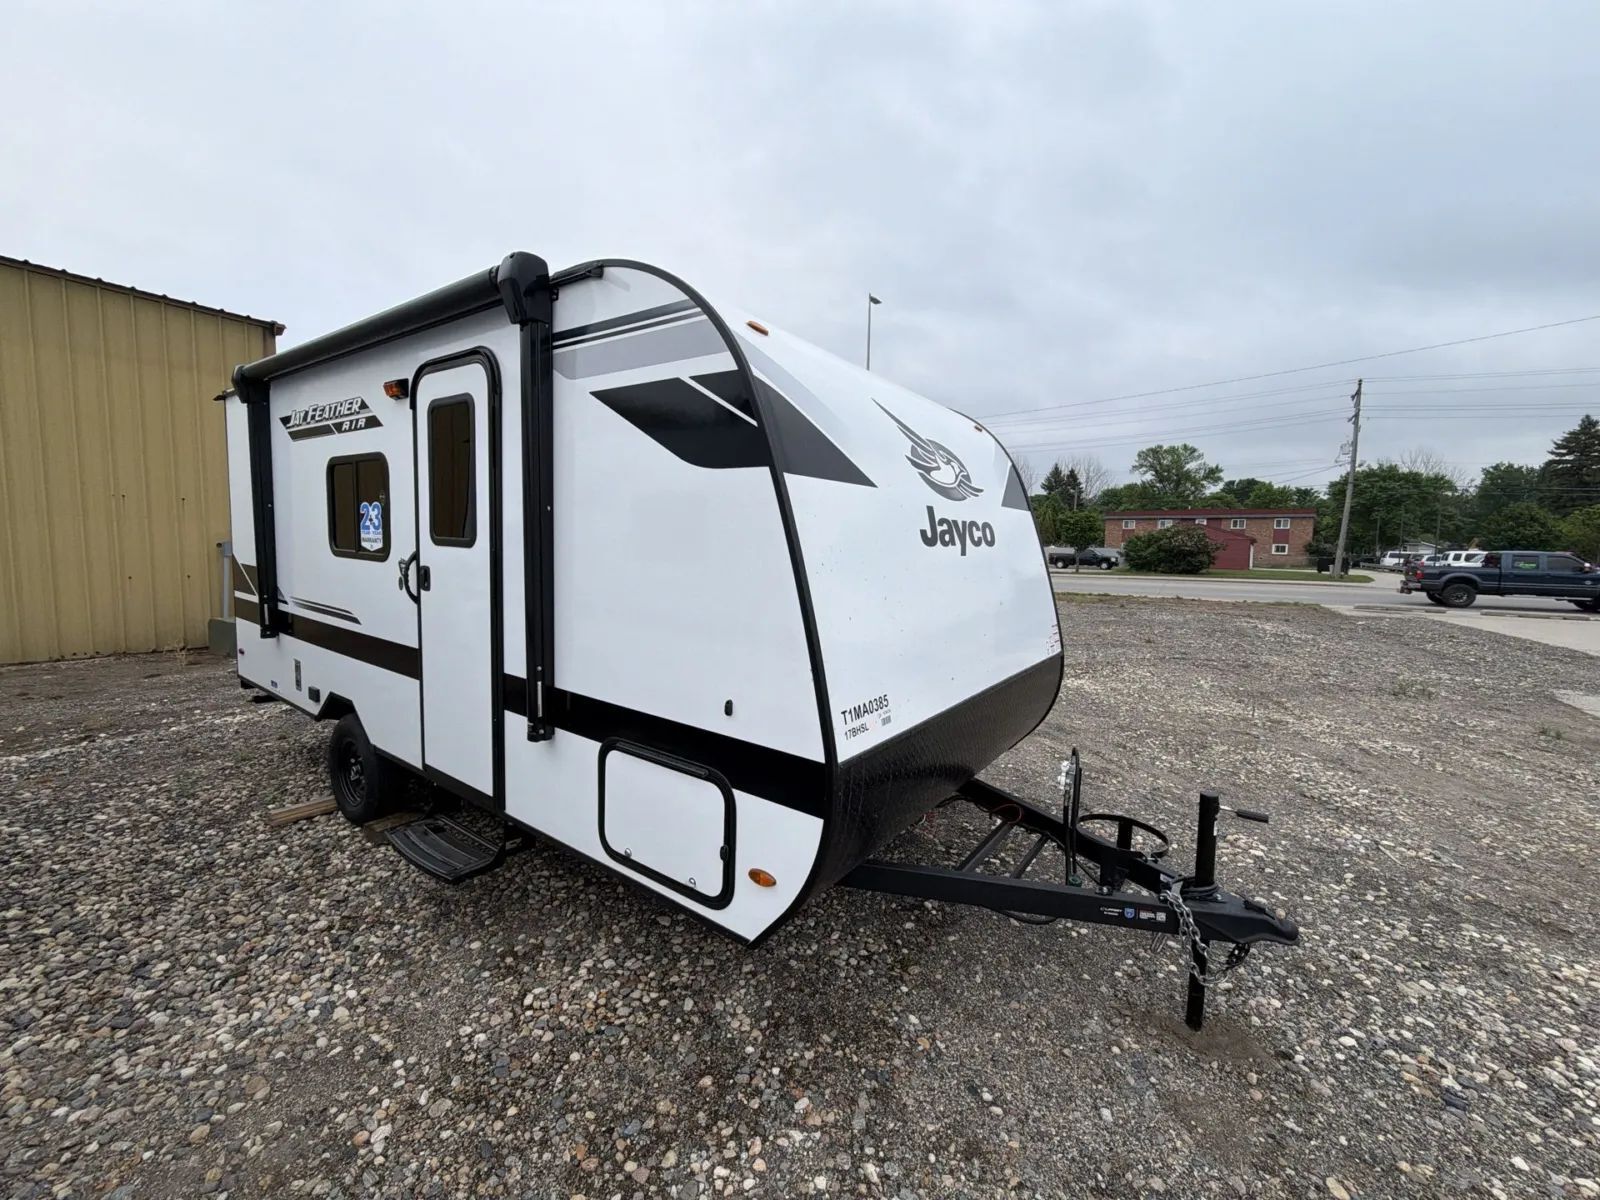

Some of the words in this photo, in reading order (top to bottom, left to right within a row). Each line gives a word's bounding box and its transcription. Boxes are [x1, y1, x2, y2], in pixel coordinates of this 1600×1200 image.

[286, 409, 305, 427] JAY
[307, 397, 361, 422] FEATHER
[342, 418, 366, 431] AIR
[920, 505, 995, 556] Jayco
[841, 694, 889, 725] T1MA0385
[845, 722, 869, 740] 17BHSL
